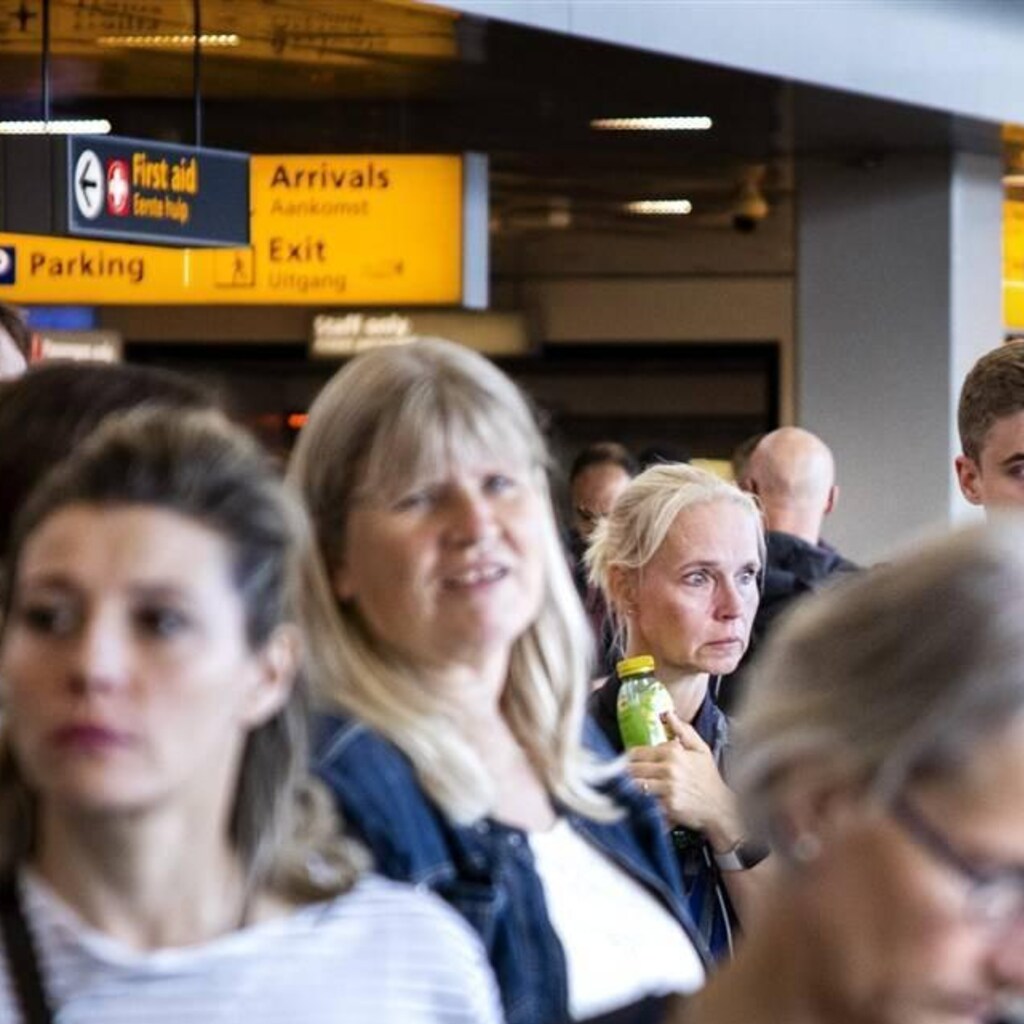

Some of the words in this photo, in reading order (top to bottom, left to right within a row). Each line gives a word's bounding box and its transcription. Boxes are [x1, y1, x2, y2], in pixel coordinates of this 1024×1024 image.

[132, 153, 168, 190] First
[171, 157, 198, 194] aid
[270, 162, 390, 189] Arrivals
[270, 197, 369, 216] Aankomst
[269, 236, 326, 263] Exit
[30, 251, 145, 285] Parking
[268, 272, 347, 293] Uitgang
